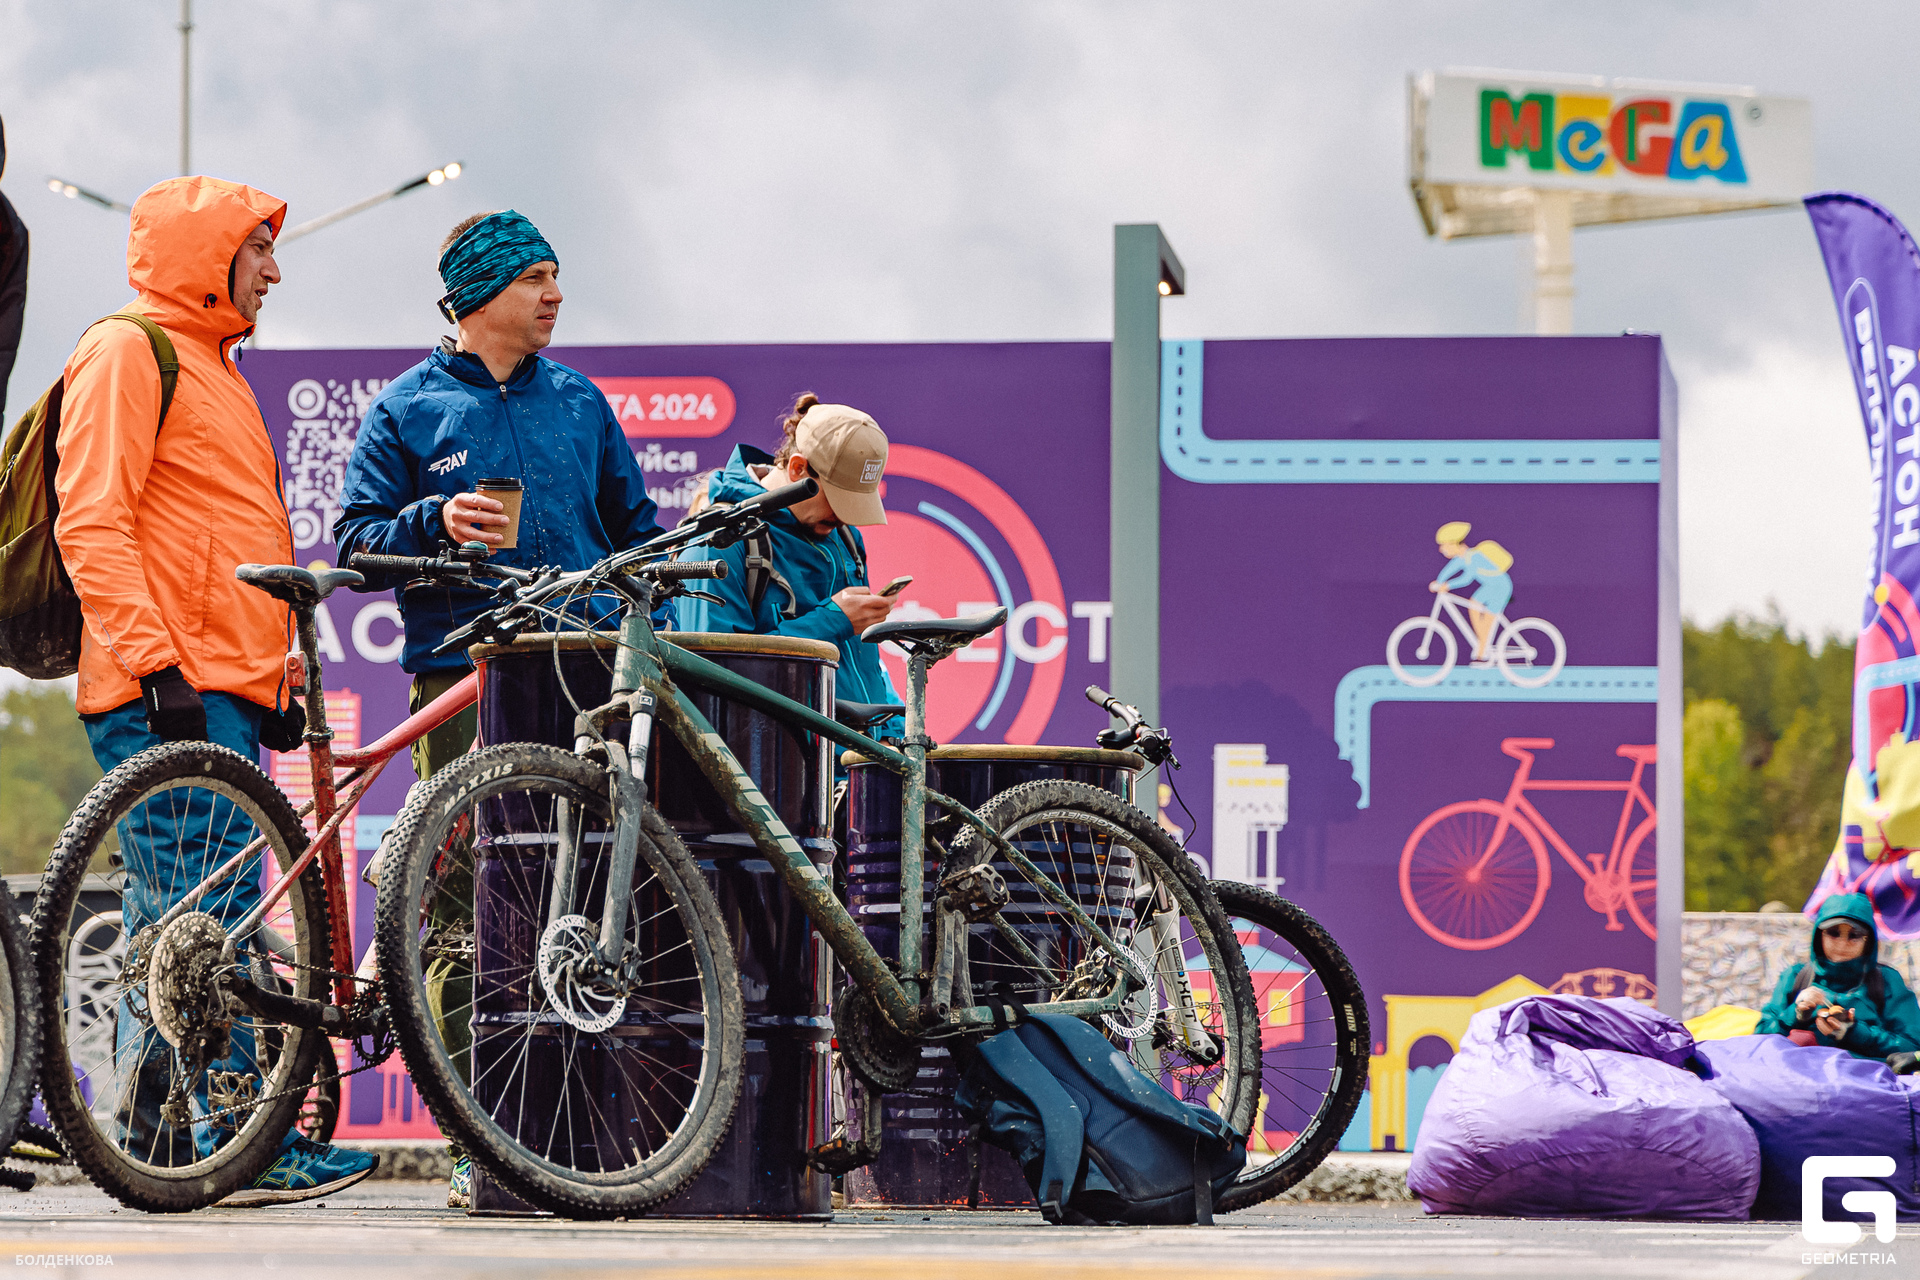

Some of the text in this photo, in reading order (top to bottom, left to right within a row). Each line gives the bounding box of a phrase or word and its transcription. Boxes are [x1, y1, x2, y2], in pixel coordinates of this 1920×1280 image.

[605, 393, 717, 420] ТА 2024
[1886, 344, 1920, 549] АСТОН
[428, 449, 468, 475] RAY
[864, 472, 878, 480] OUT
[865, 464, 881, 472] STAY
[1041, 810, 1134, 841] FELGEBIETER
[1177, 980, 1198, 1022] XCT
[1238, 1119, 1322, 1184] FELGEBIETER
